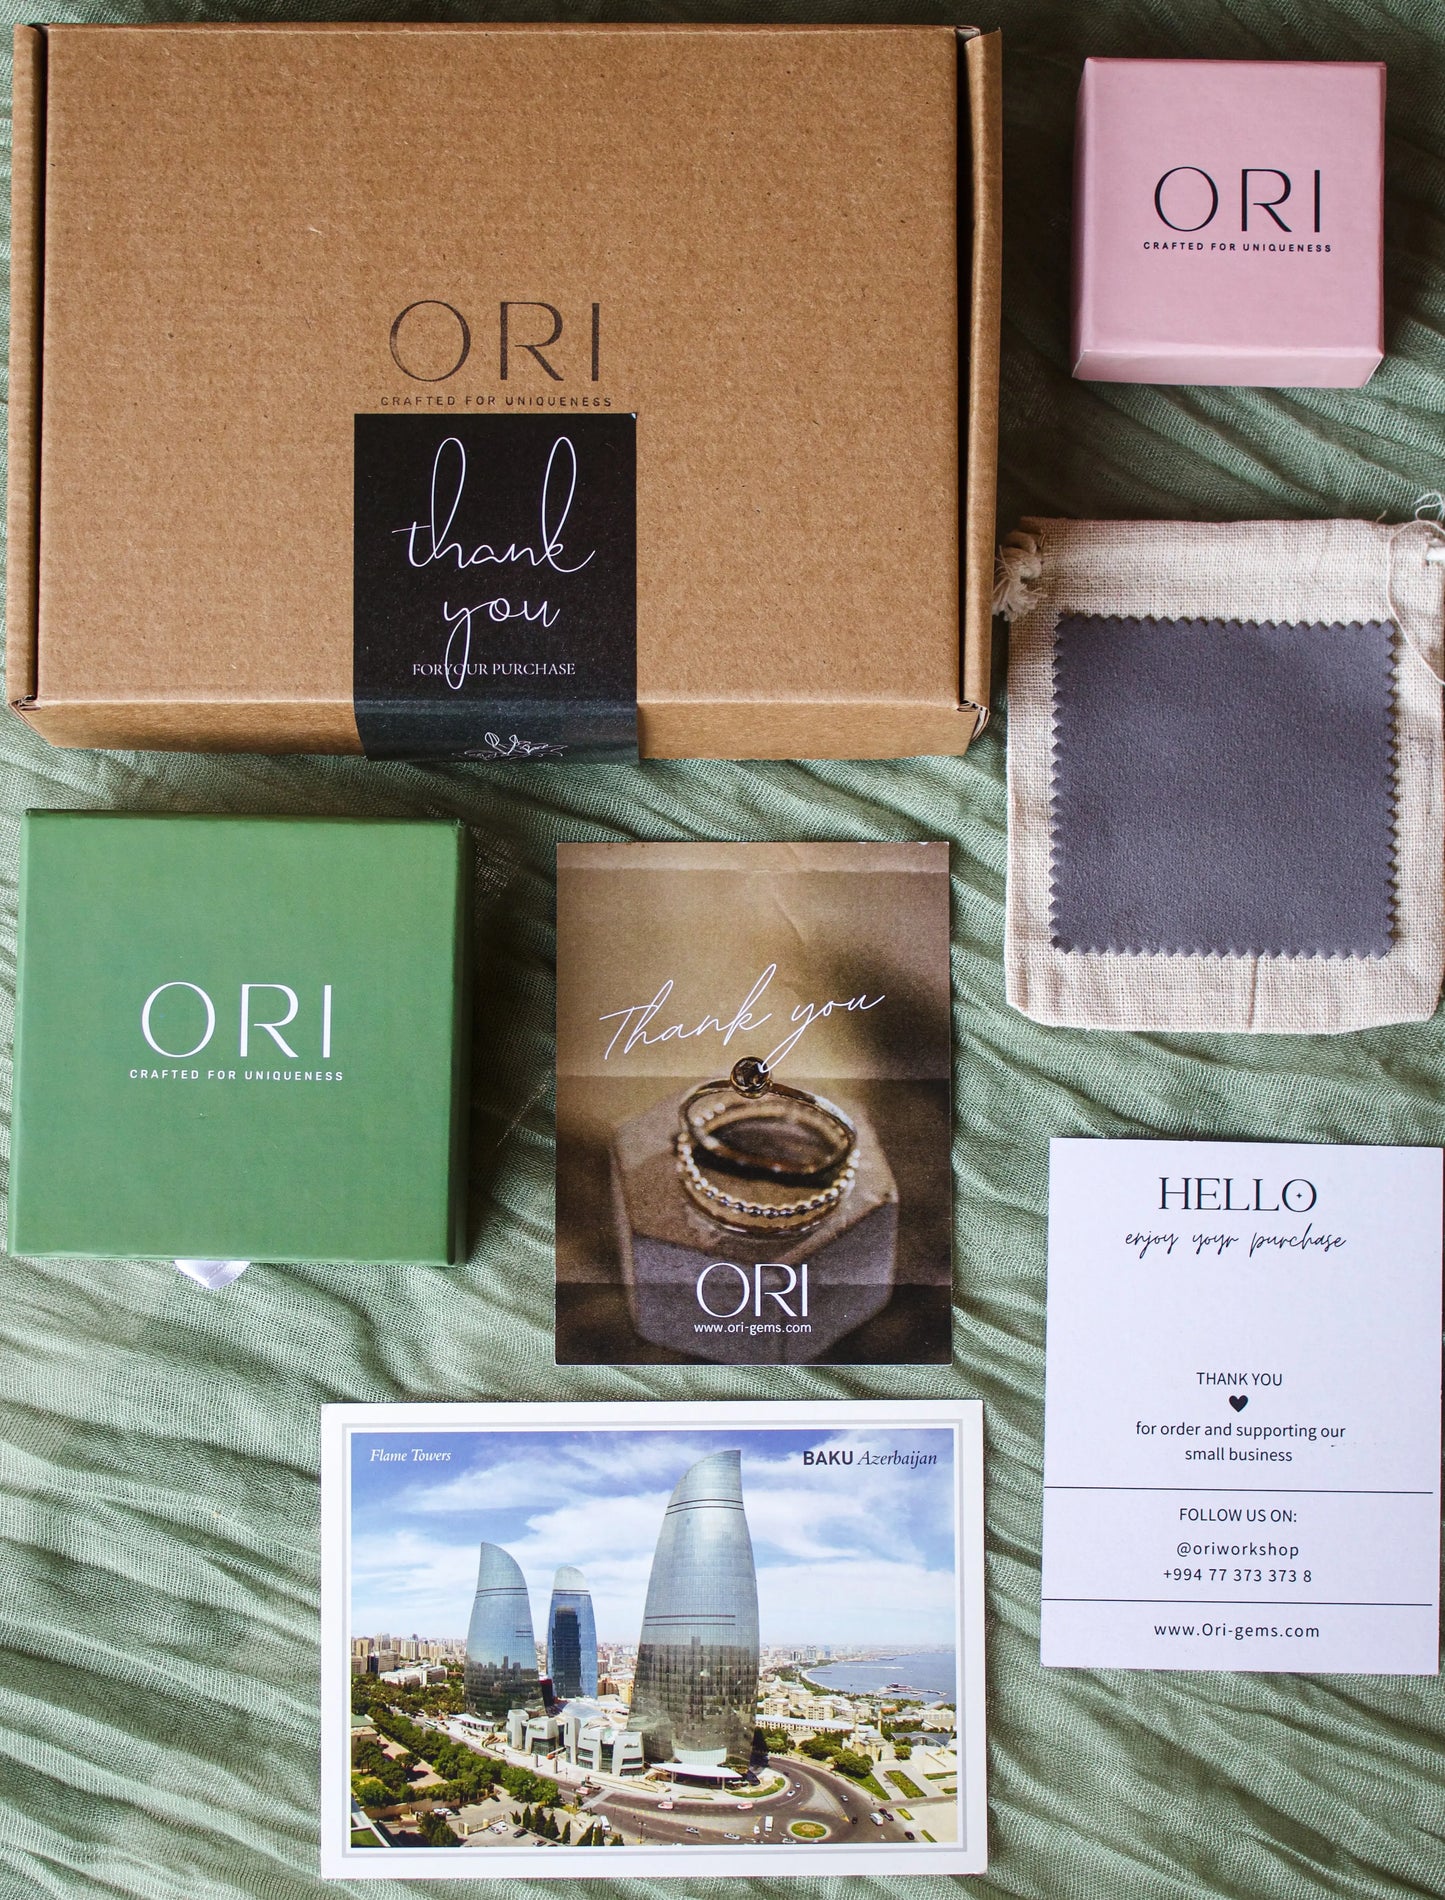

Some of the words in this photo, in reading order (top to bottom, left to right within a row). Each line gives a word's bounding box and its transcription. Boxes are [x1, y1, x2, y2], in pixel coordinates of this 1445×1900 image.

[1154, 166, 1321, 233] ORI
[1143, 241, 1204, 251] CRAFTED
[1210, 242, 1236, 251] FOR
[1242, 243, 1331, 253] UNIQUENESS
[389, 299, 601, 383] ORI
[380, 395, 456, 406] CRAFTED
[465, 395, 496, 406] FOR
[505, 396, 612, 407] UNIQUENESS
[391, 436, 596, 573] thank
[443, 597, 561, 690] you
[491, 662, 576, 676] PURCHASE
[141, 981, 332, 1058] ORI
[599, 963, 778, 1061] Thank
[756, 993, 886, 1074] you
[129, 1069, 199, 1080] CRAFTED
[207, 1070, 236, 1080] FOR
[244, 1070, 343, 1081] UNIQUENESS
[1158, 1176, 1318, 1213] HELLO
[1125, 1232, 1179, 1260] enjoy
[1248, 1222, 1347, 1258] purchase
[696, 1262, 808, 1318] ORI
[693, 1321, 812, 1336] www.ori-gems.com
[1195, 1371, 1248, 1387] THANK
[1251, 1372, 1283, 1387] YOU
[1136, 1420, 1157, 1435] for
[1160, 1421, 1201, 1436] order
[1204, 1422, 1232, 1437] and
[1236, 1423, 1318, 1442] supporting
[1320, 1427, 1346, 1438] our
[369, 1448, 408, 1462] Flame
[411, 1448, 452, 1462] Towers
[802, 1450, 853, 1466] BAKU
[857, 1449, 938, 1470] Azerbaijan
[1185, 1447, 1225, 1461] small
[1229, 1447, 1293, 1462] business
[1178, 1507, 1242, 1522] FOLLOW
[1246, 1508, 1266, 1523] US
[1270, 1509, 1297, 1523] ON:
[1176, 1541, 1299, 1560] @oriworkshop
[1163, 1567, 1202, 1581] +994
[1208, 1568, 1227, 1582] 77
[1233, 1568, 1262, 1582] 373
[1268, 1569, 1297, 1583] 373
[1303, 1569, 1312, 1583] 8
[1154, 1622, 1320, 1641] www.Ori-gems.com
